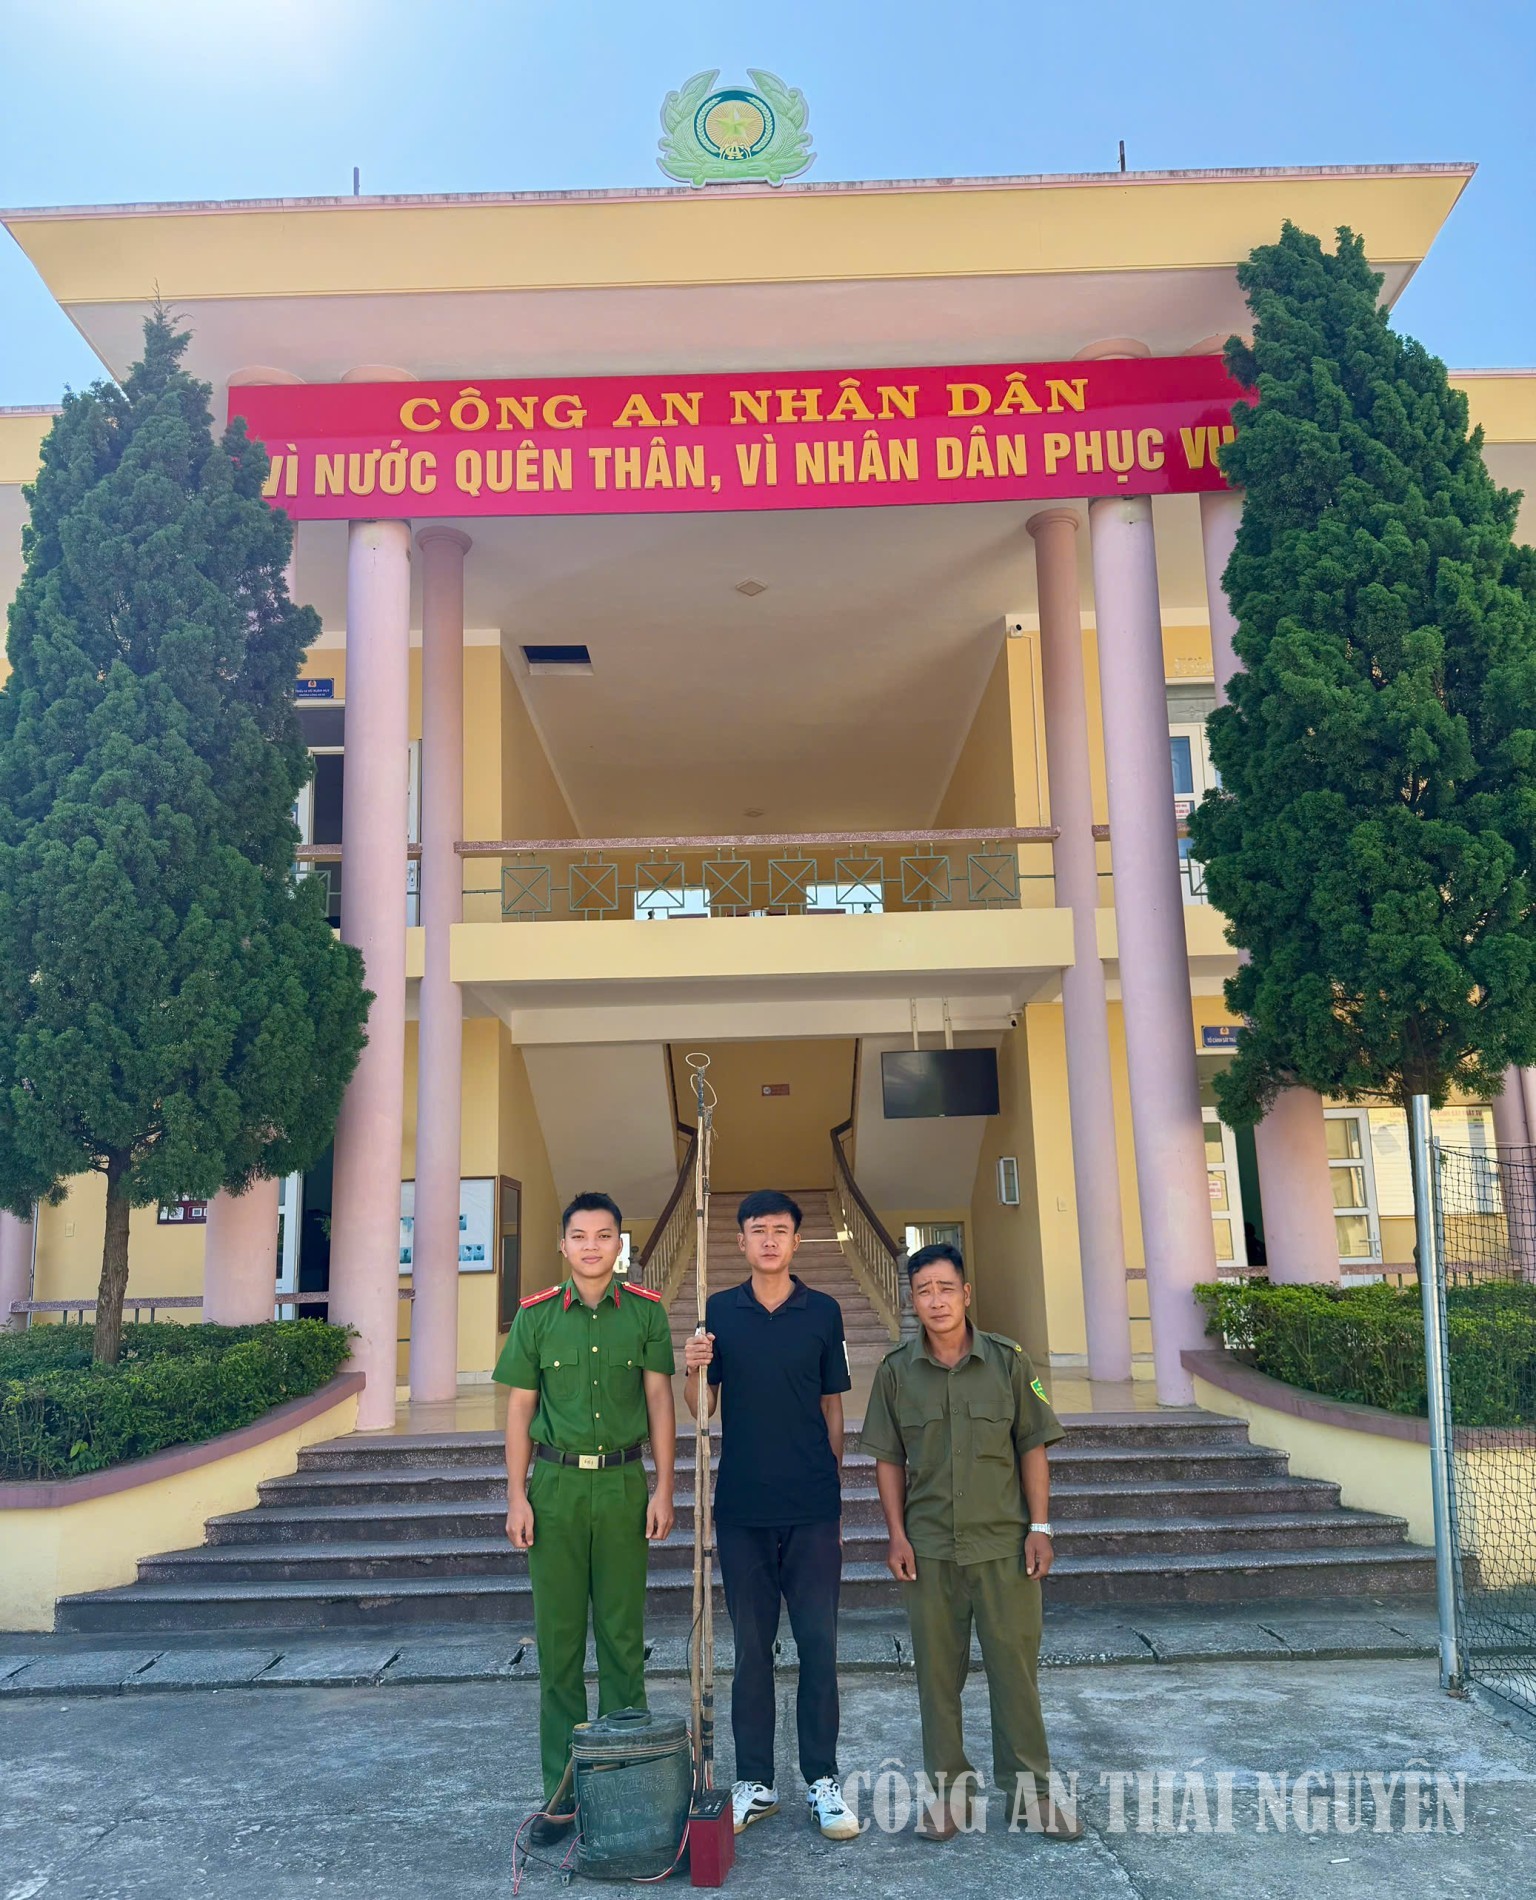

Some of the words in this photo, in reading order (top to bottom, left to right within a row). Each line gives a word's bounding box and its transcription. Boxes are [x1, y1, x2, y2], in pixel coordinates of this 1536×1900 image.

[399, 387, 588, 432] CÔNG
[612, 391, 704, 429] AN
[730, 377, 919, 425] NHÂN
[946, 371, 1089, 417] DÂN
[314, 440, 438, 497] NƯỚC
[455, 440, 574, 498] QUÊN
[589, 436, 722, 494] THÂN,
[736, 433, 778, 487] VÌ
[795, 429, 919, 485] NHÂN
[936, 425, 1028, 480] DÂN
[1044, 427, 1166, 484] PHỤC
